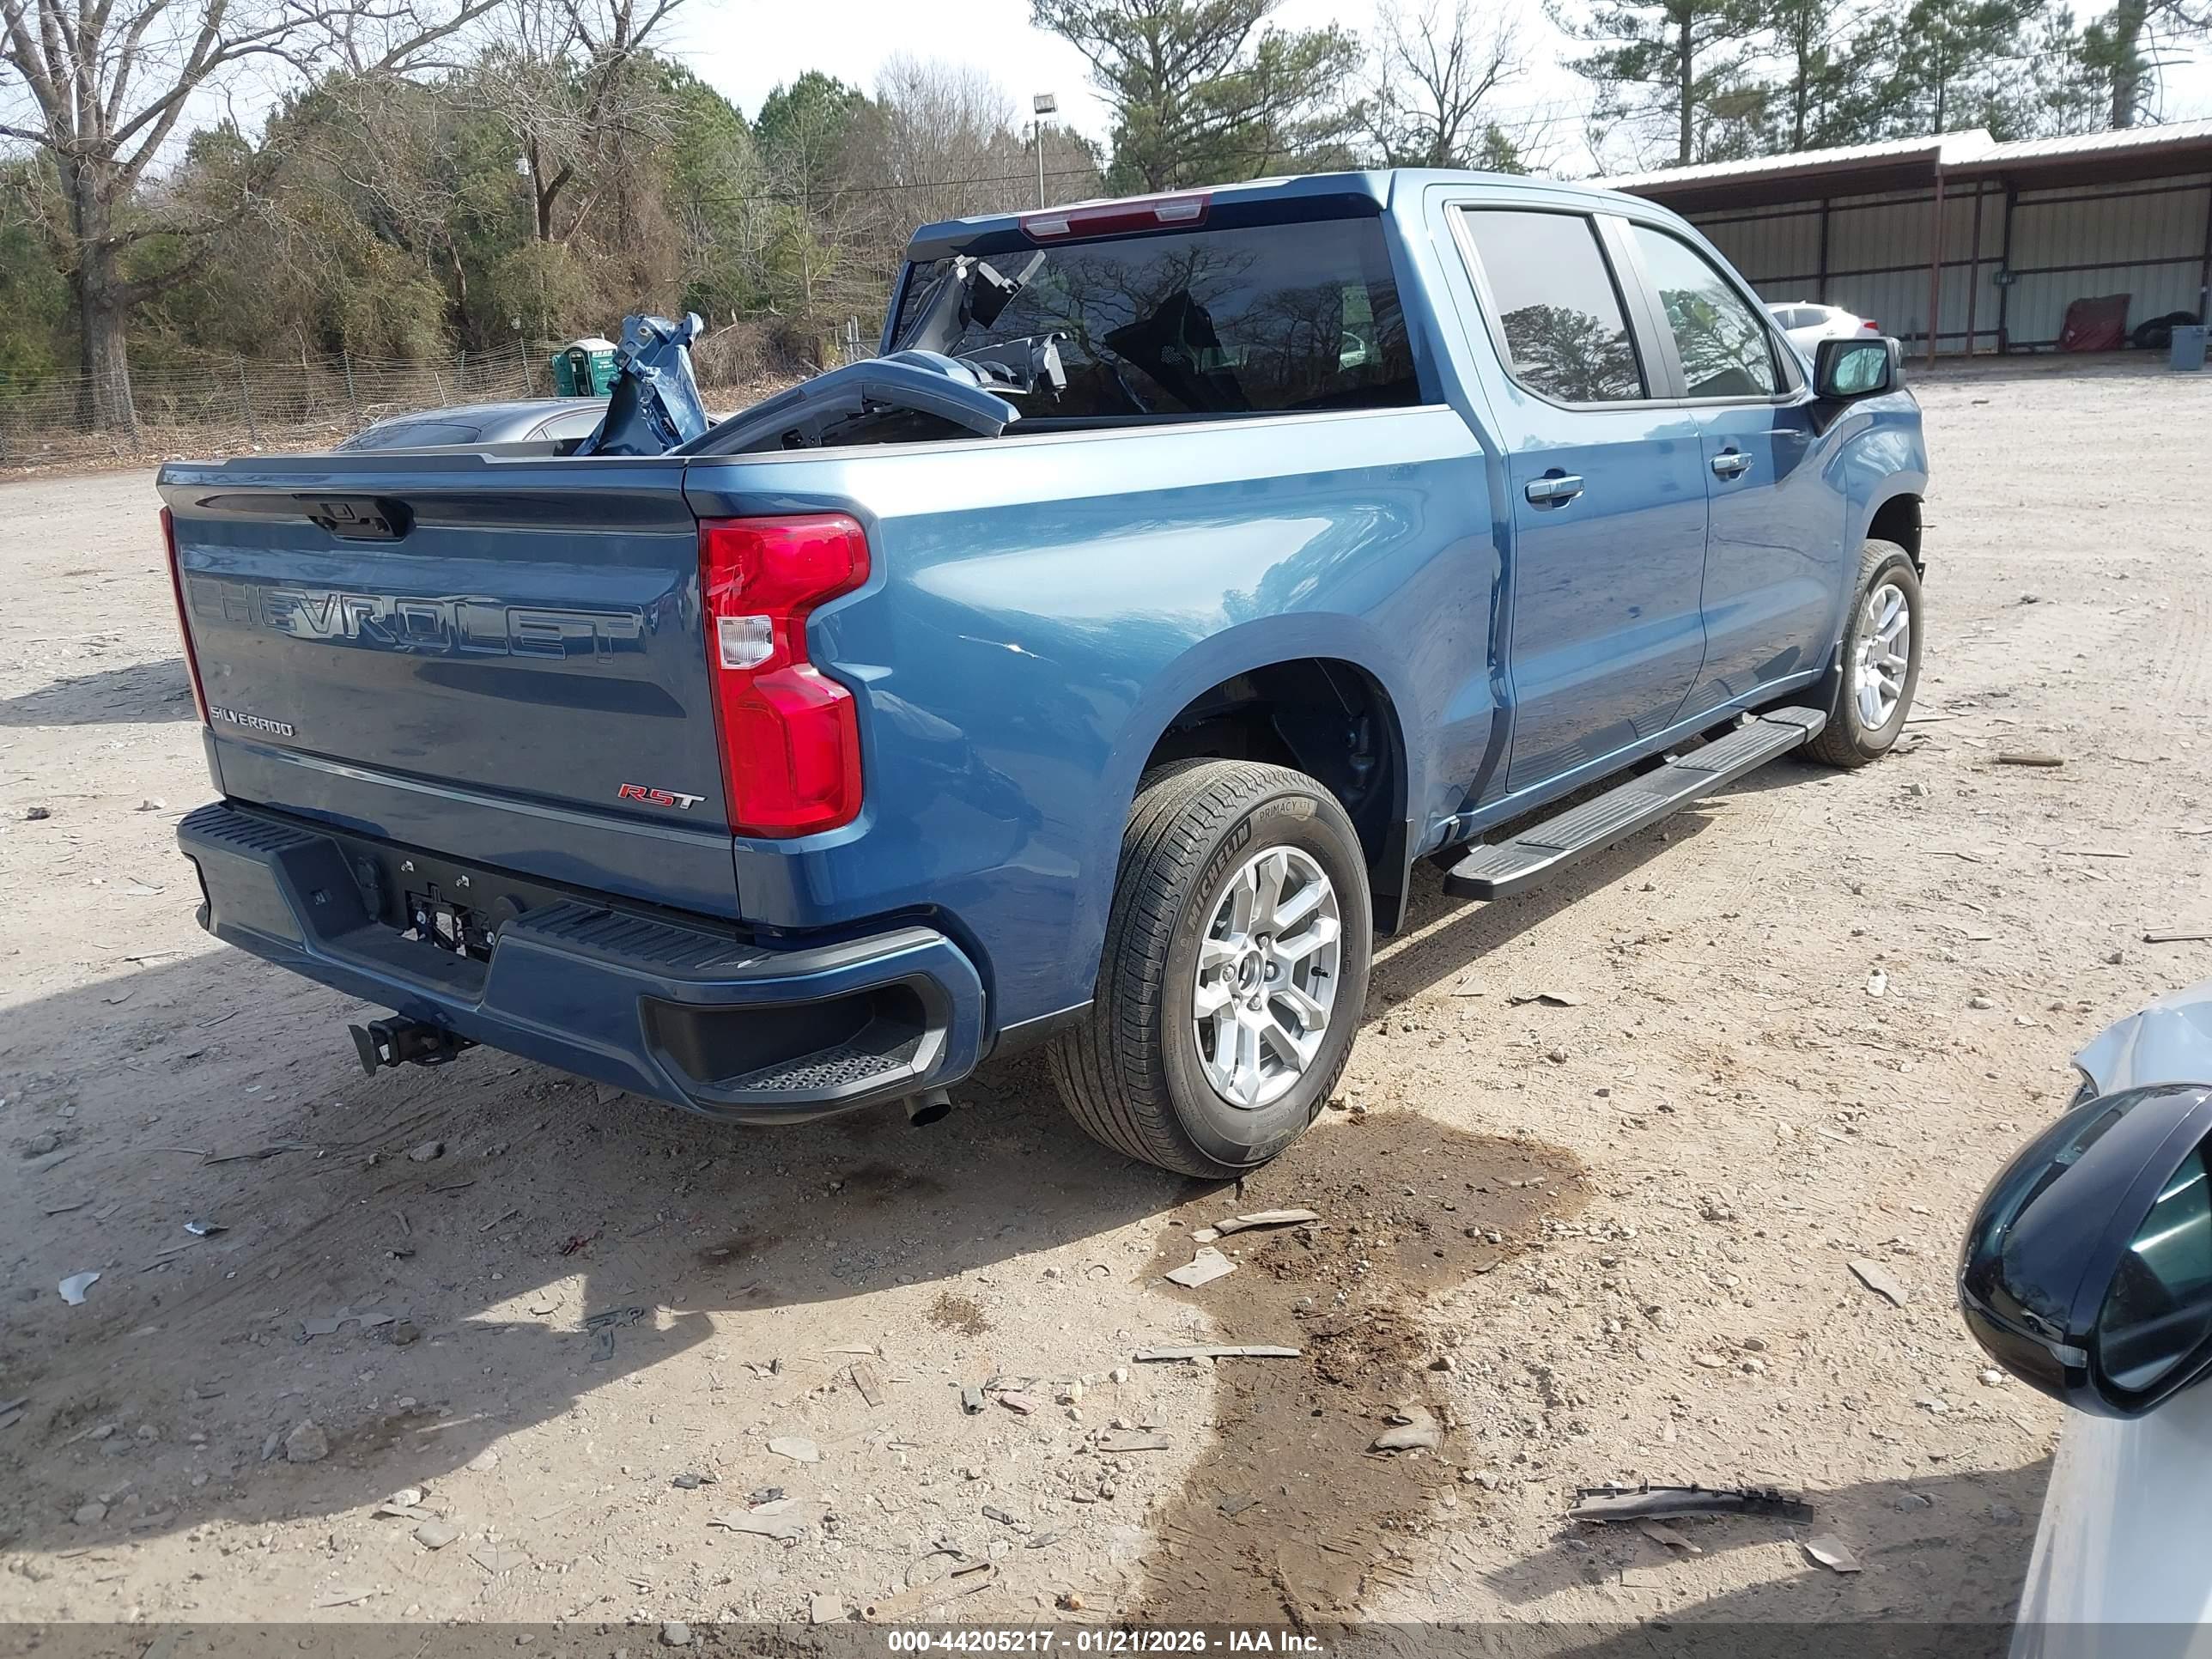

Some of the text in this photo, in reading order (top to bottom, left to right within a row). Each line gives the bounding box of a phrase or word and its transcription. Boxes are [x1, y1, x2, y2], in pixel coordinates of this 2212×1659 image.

[188, 578, 645, 665] CHEVROLET
[210, 705, 294, 738] SILVERADO
[617, 782, 708, 810] RST
[1259, 799, 1297, 823] PRIMACY
[1187, 822, 1250, 932] MICHELIN
